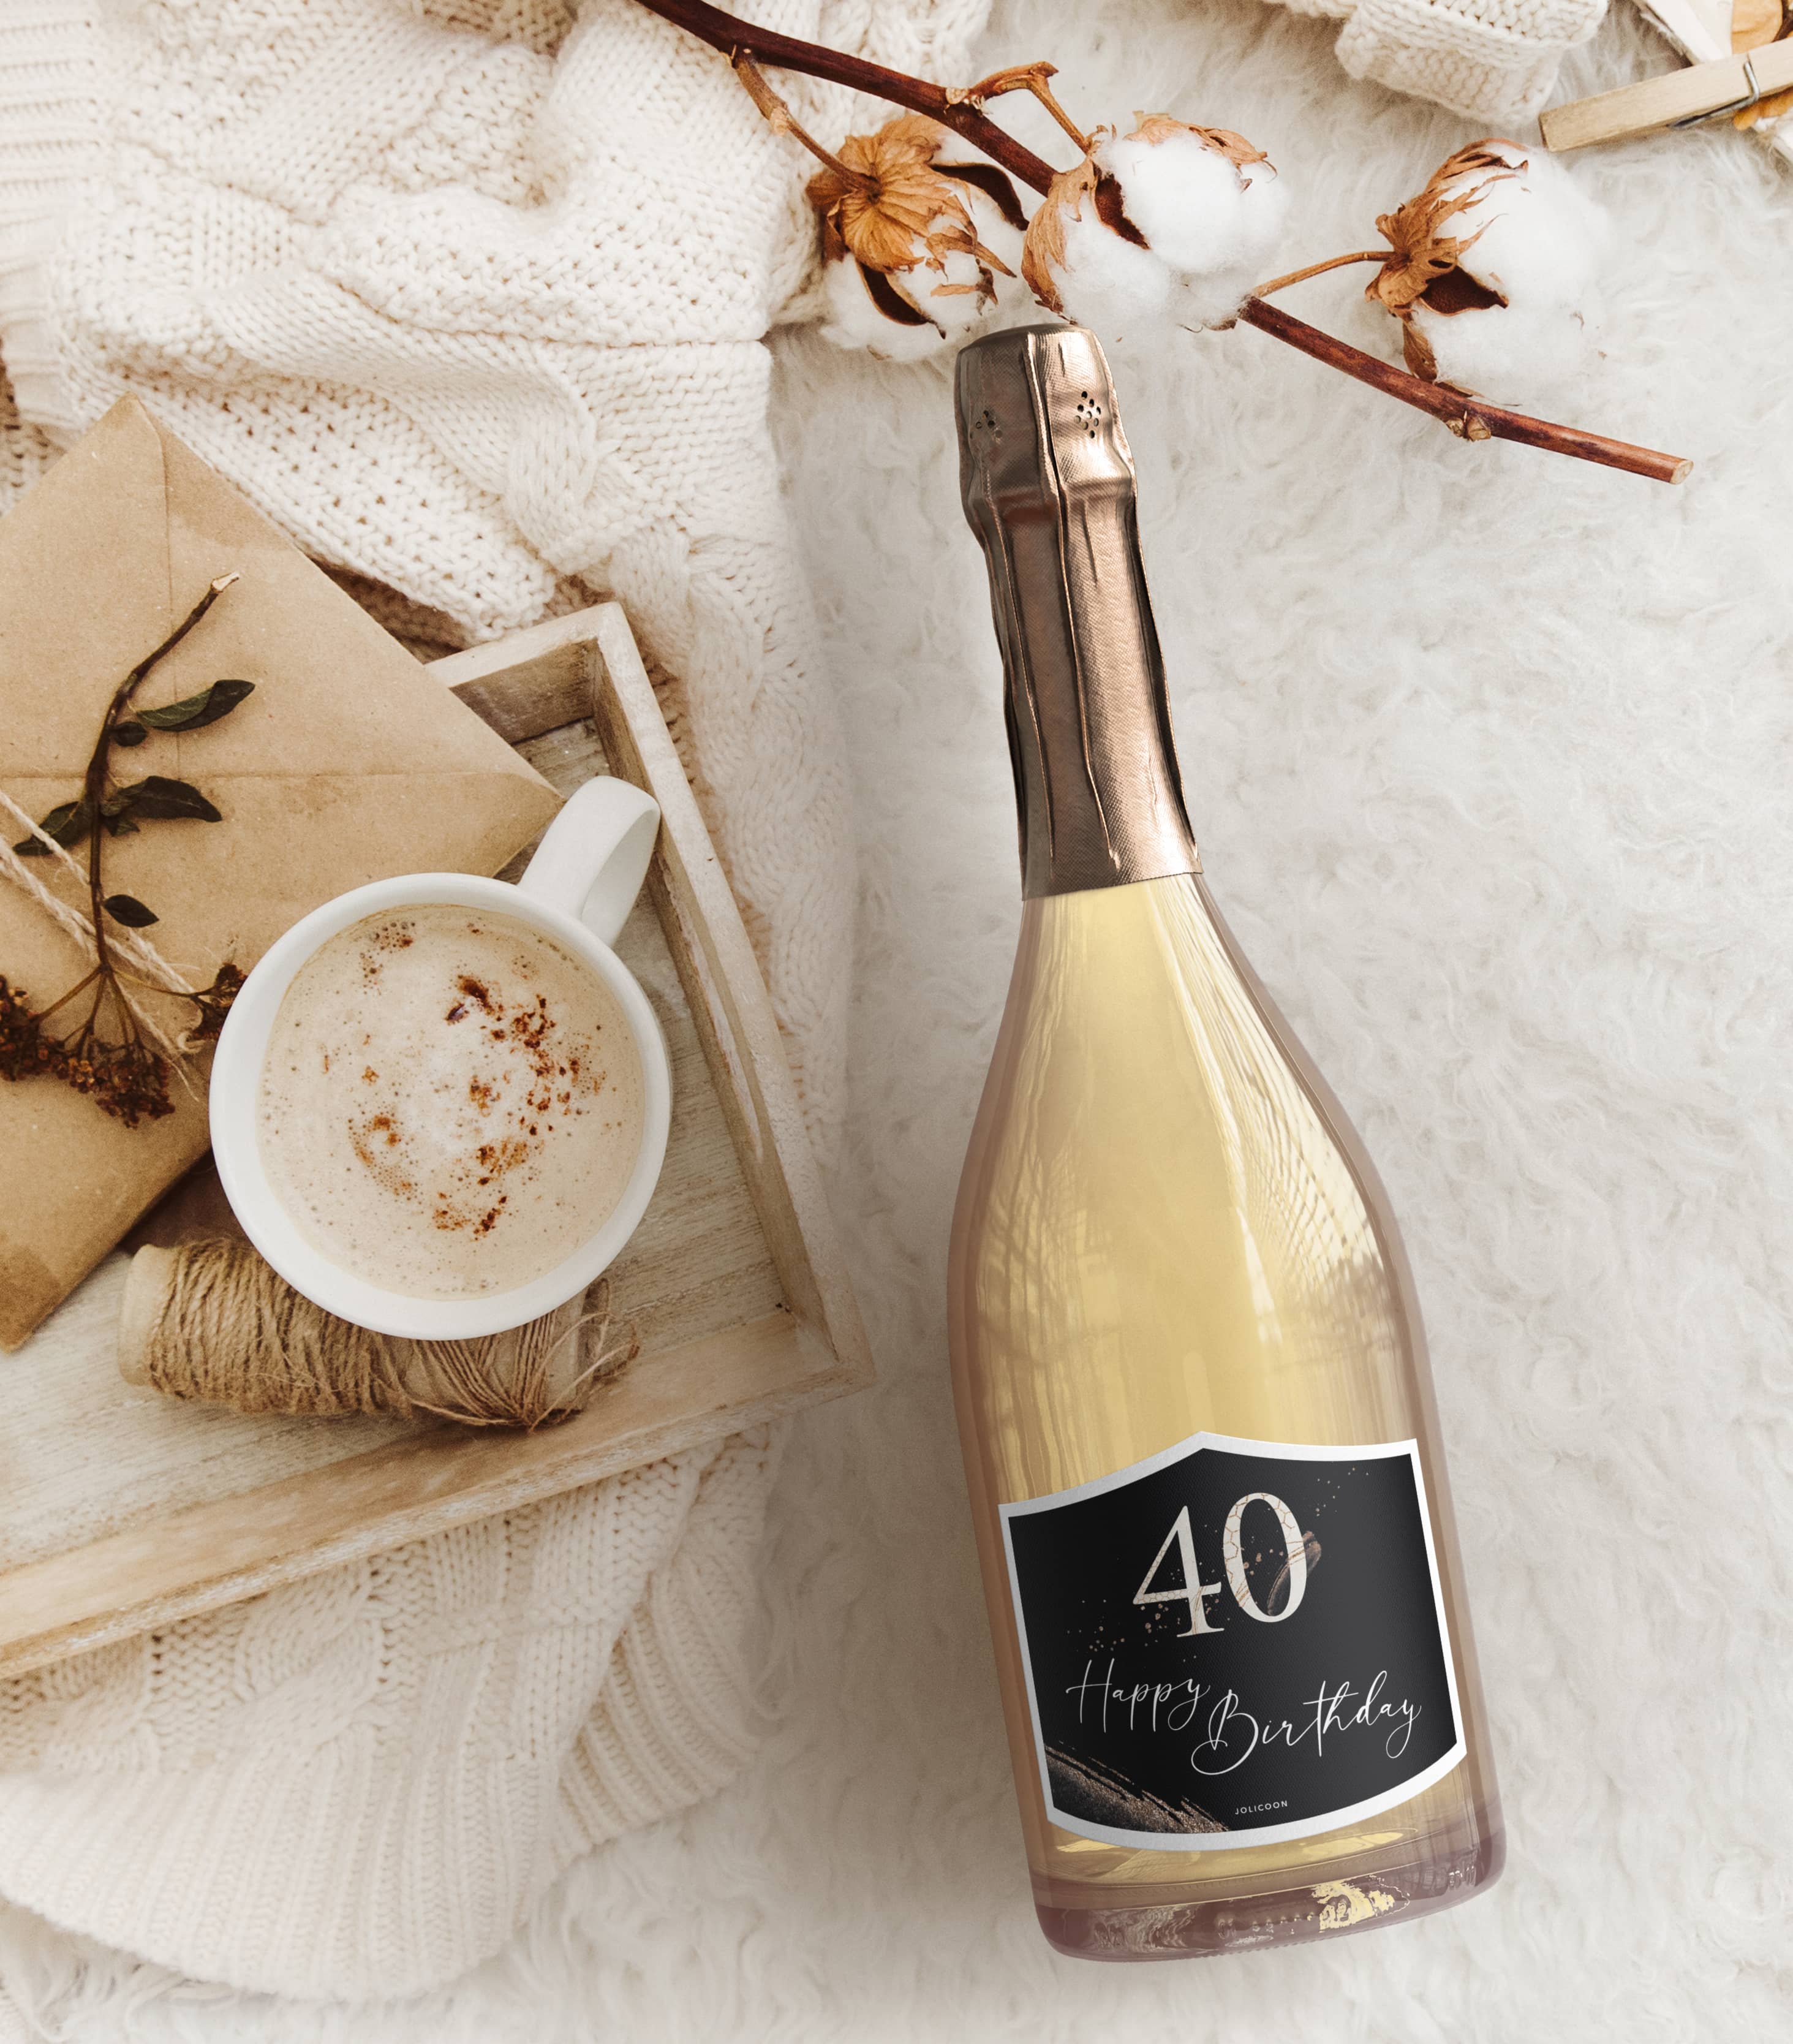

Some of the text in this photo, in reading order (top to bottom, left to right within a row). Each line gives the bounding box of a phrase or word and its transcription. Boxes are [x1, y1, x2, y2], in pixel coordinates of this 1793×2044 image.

[1133, 1492, 1308, 1638] 40
[1065, 1658, 1422, 1776] Happy Birthday
[1235, 1800, 1288, 1815] JOLICOON
